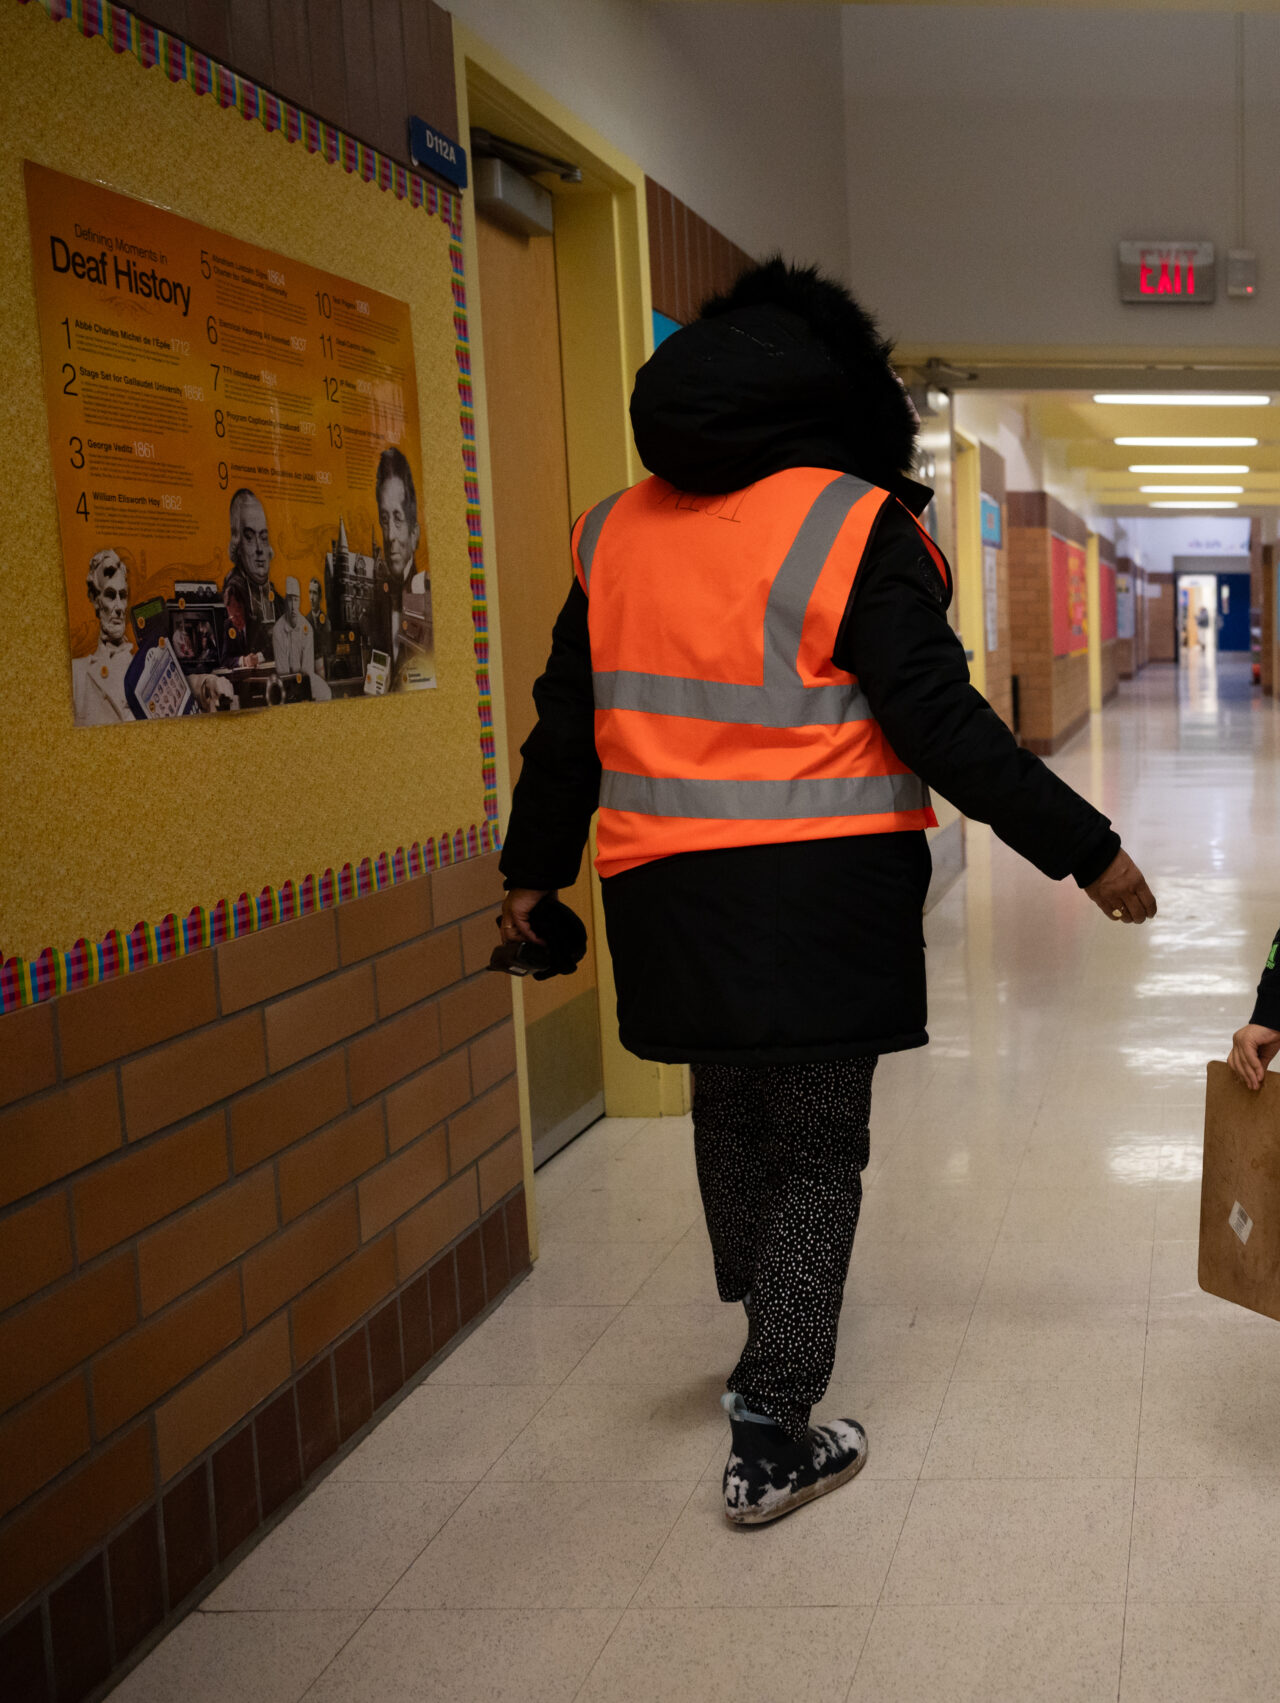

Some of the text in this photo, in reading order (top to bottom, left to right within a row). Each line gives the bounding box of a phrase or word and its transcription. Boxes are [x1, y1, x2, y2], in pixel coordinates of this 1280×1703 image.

[425, 129, 456, 165] D112A
[75, 223, 168, 264] Defining Moments in
[50, 236, 107, 285] Deaf
[114, 256, 191, 317] History
[201, 250, 211, 280] 5
[1140, 249, 1198, 294] EXIT
[315, 290, 331, 319] 10
[61, 317, 71, 349] 1
[94, 323, 119, 338] Charles
[171, 337, 191, 356] 1712
[206, 315, 218, 345] 6
[320, 333, 333, 360] 11
[62, 363, 78, 396] 2
[79, 366, 99, 380] Stage
[100, 371, 113, 381] Set
[113, 374, 122, 383] for
[123, 376, 153, 389] Gallaudet
[155, 382, 182, 396] University
[210, 364, 221, 391] 7
[322, 376, 339, 404] 12
[214, 409, 225, 438] 8
[326, 422, 343, 449] 13
[69, 436, 85, 469] 3
[87, 439, 112, 453] George
[132, 441, 155, 458] 1861
[217, 461, 229, 490] 9
[76, 491, 90, 522] 4
[92, 491, 116, 502] William
[161, 495, 182, 510] 1862
